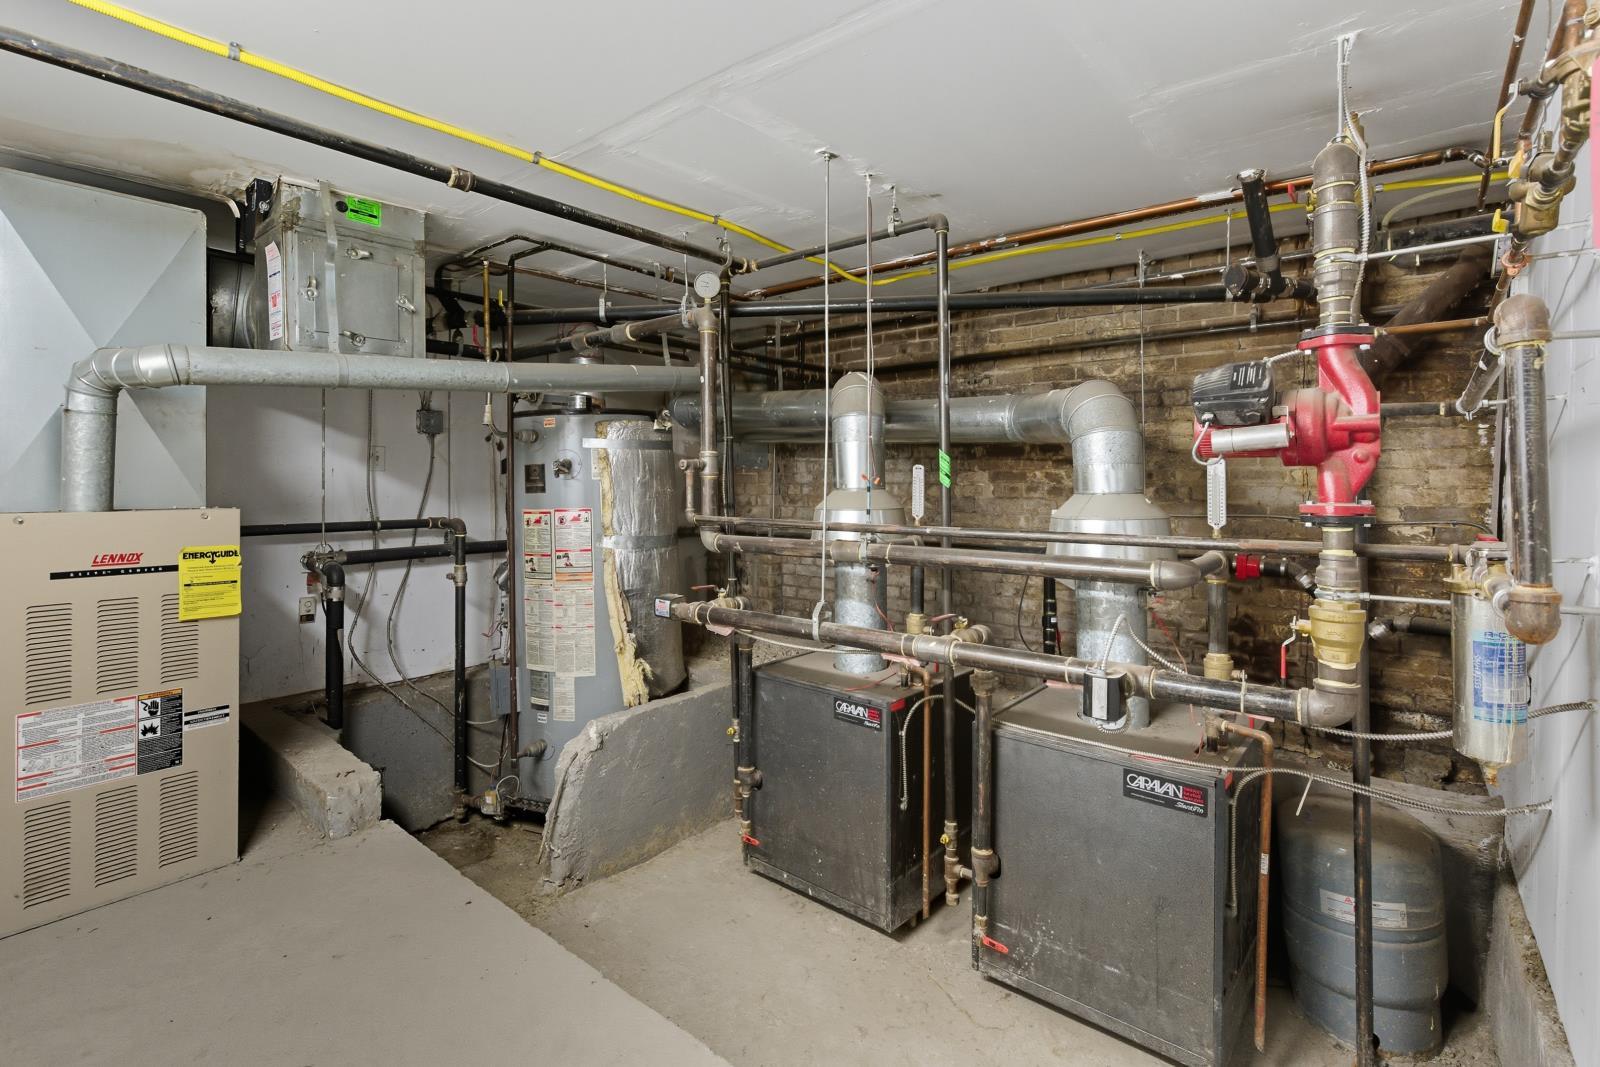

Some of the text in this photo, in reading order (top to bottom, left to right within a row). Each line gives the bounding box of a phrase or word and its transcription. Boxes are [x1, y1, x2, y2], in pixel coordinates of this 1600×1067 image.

[92, 552, 144, 564] LENNOX
[183, 550, 239, 560] ENERGYGUIDE
[835, 700, 868, 718] CARAVAN
[1126, 773, 1183, 799] CARAVAN
